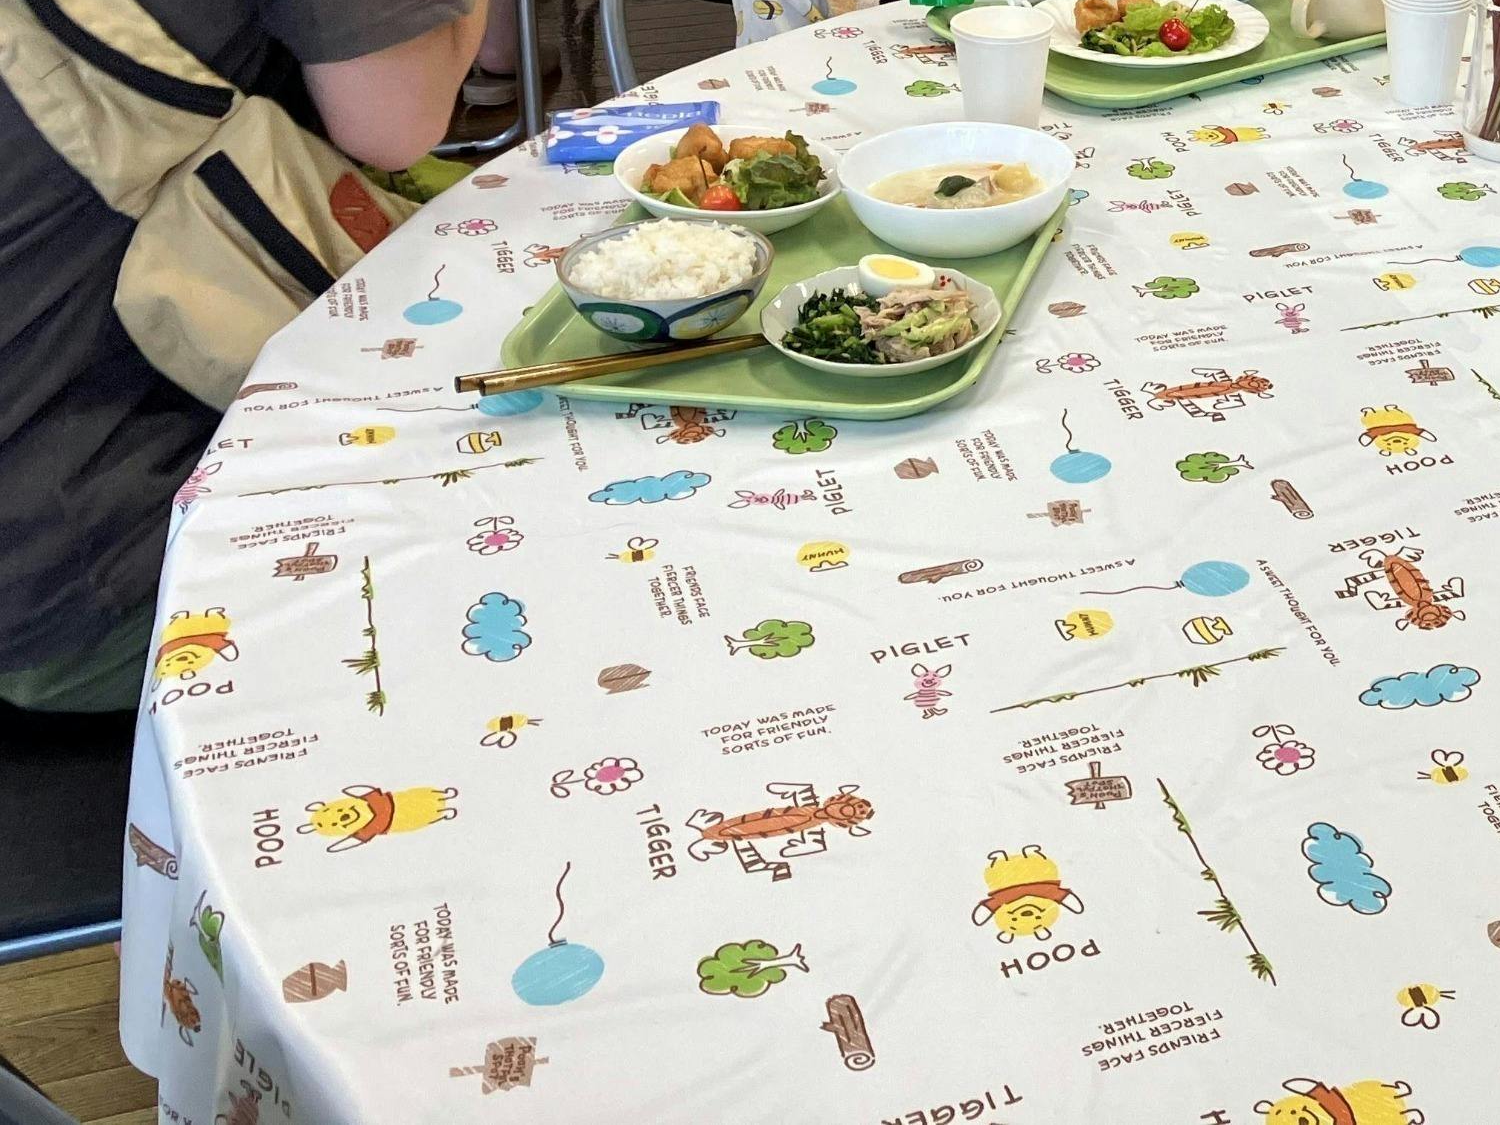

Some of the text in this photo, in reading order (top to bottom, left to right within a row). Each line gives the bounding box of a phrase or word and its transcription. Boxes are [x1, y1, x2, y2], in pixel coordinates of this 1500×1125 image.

[1160, 131, 1190, 153] POOH
[1369, 133, 1405, 163] TIGGER
[1166, 189, 1203, 217] PIGLET
[491, 240, 515, 275] TIGGER
[1243, 285, 1314, 304] PIGLET
[279, 399, 309, 409] FOR
[315, 394, 380, 404] THOUGHT
[387, 387, 431, 399] SWEET
[1103, 377, 1144, 421] TIGGER
[1385, 454, 1455, 476] POOH
[815, 468, 853, 516] PIGLET
[1453, 502, 1498, 516] THINGS
[1466, 511, 1499, 523] FACE
[1328, 526, 1421, 555] TIGGER
[1011, 571, 1077, 589] THOUGHT
[1080, 561, 1123, 575] SWEET
[662, 564, 693, 626] FIERCER THINGS
[682, 565, 711, 618] FRIENDS FACE
[938, 592, 974, 603] YOU.
[976, 584, 1007, 596] FOR
[1260, 565, 1285, 588] SWEET
[1279, 587, 1312, 626] THOUGHT
[1306, 625, 1327, 646] FOR
[869, 633, 971, 664] PIGLET
[701, 703, 837, 738] TODAY WAS MADE
[720, 714, 828, 744] FOR FRIENDLY
[173, 733, 319, 770] FIERCER THINGS
[721, 725, 832, 756] SORTS OF FUN.
[1002, 729, 1125, 764] FIERCER THINGS
[182, 747, 308, 780] FRIENDS FACE
[1016, 743, 1122, 774] FRIENDS FACE
[253, 808, 284, 869] POOH
[636, 803, 677, 881] TIGGER
[390, 924, 409, 960] SORTS
[433, 902, 460, 1005] TODAY WAS MADE
[393, 960, 412, 977] OF
[413, 919, 437, 1000] FOR FRIENDLY
[1000, 938, 1101, 979] POOH
[1081, 1009, 1224, 1057] FIERCER THINGS
[1098, 1001, 1194, 1035] TOGETHER.
[1097, 1028, 1222, 1072] FRIENDS FACE
[234, 1038, 291, 1120] PIGLE
